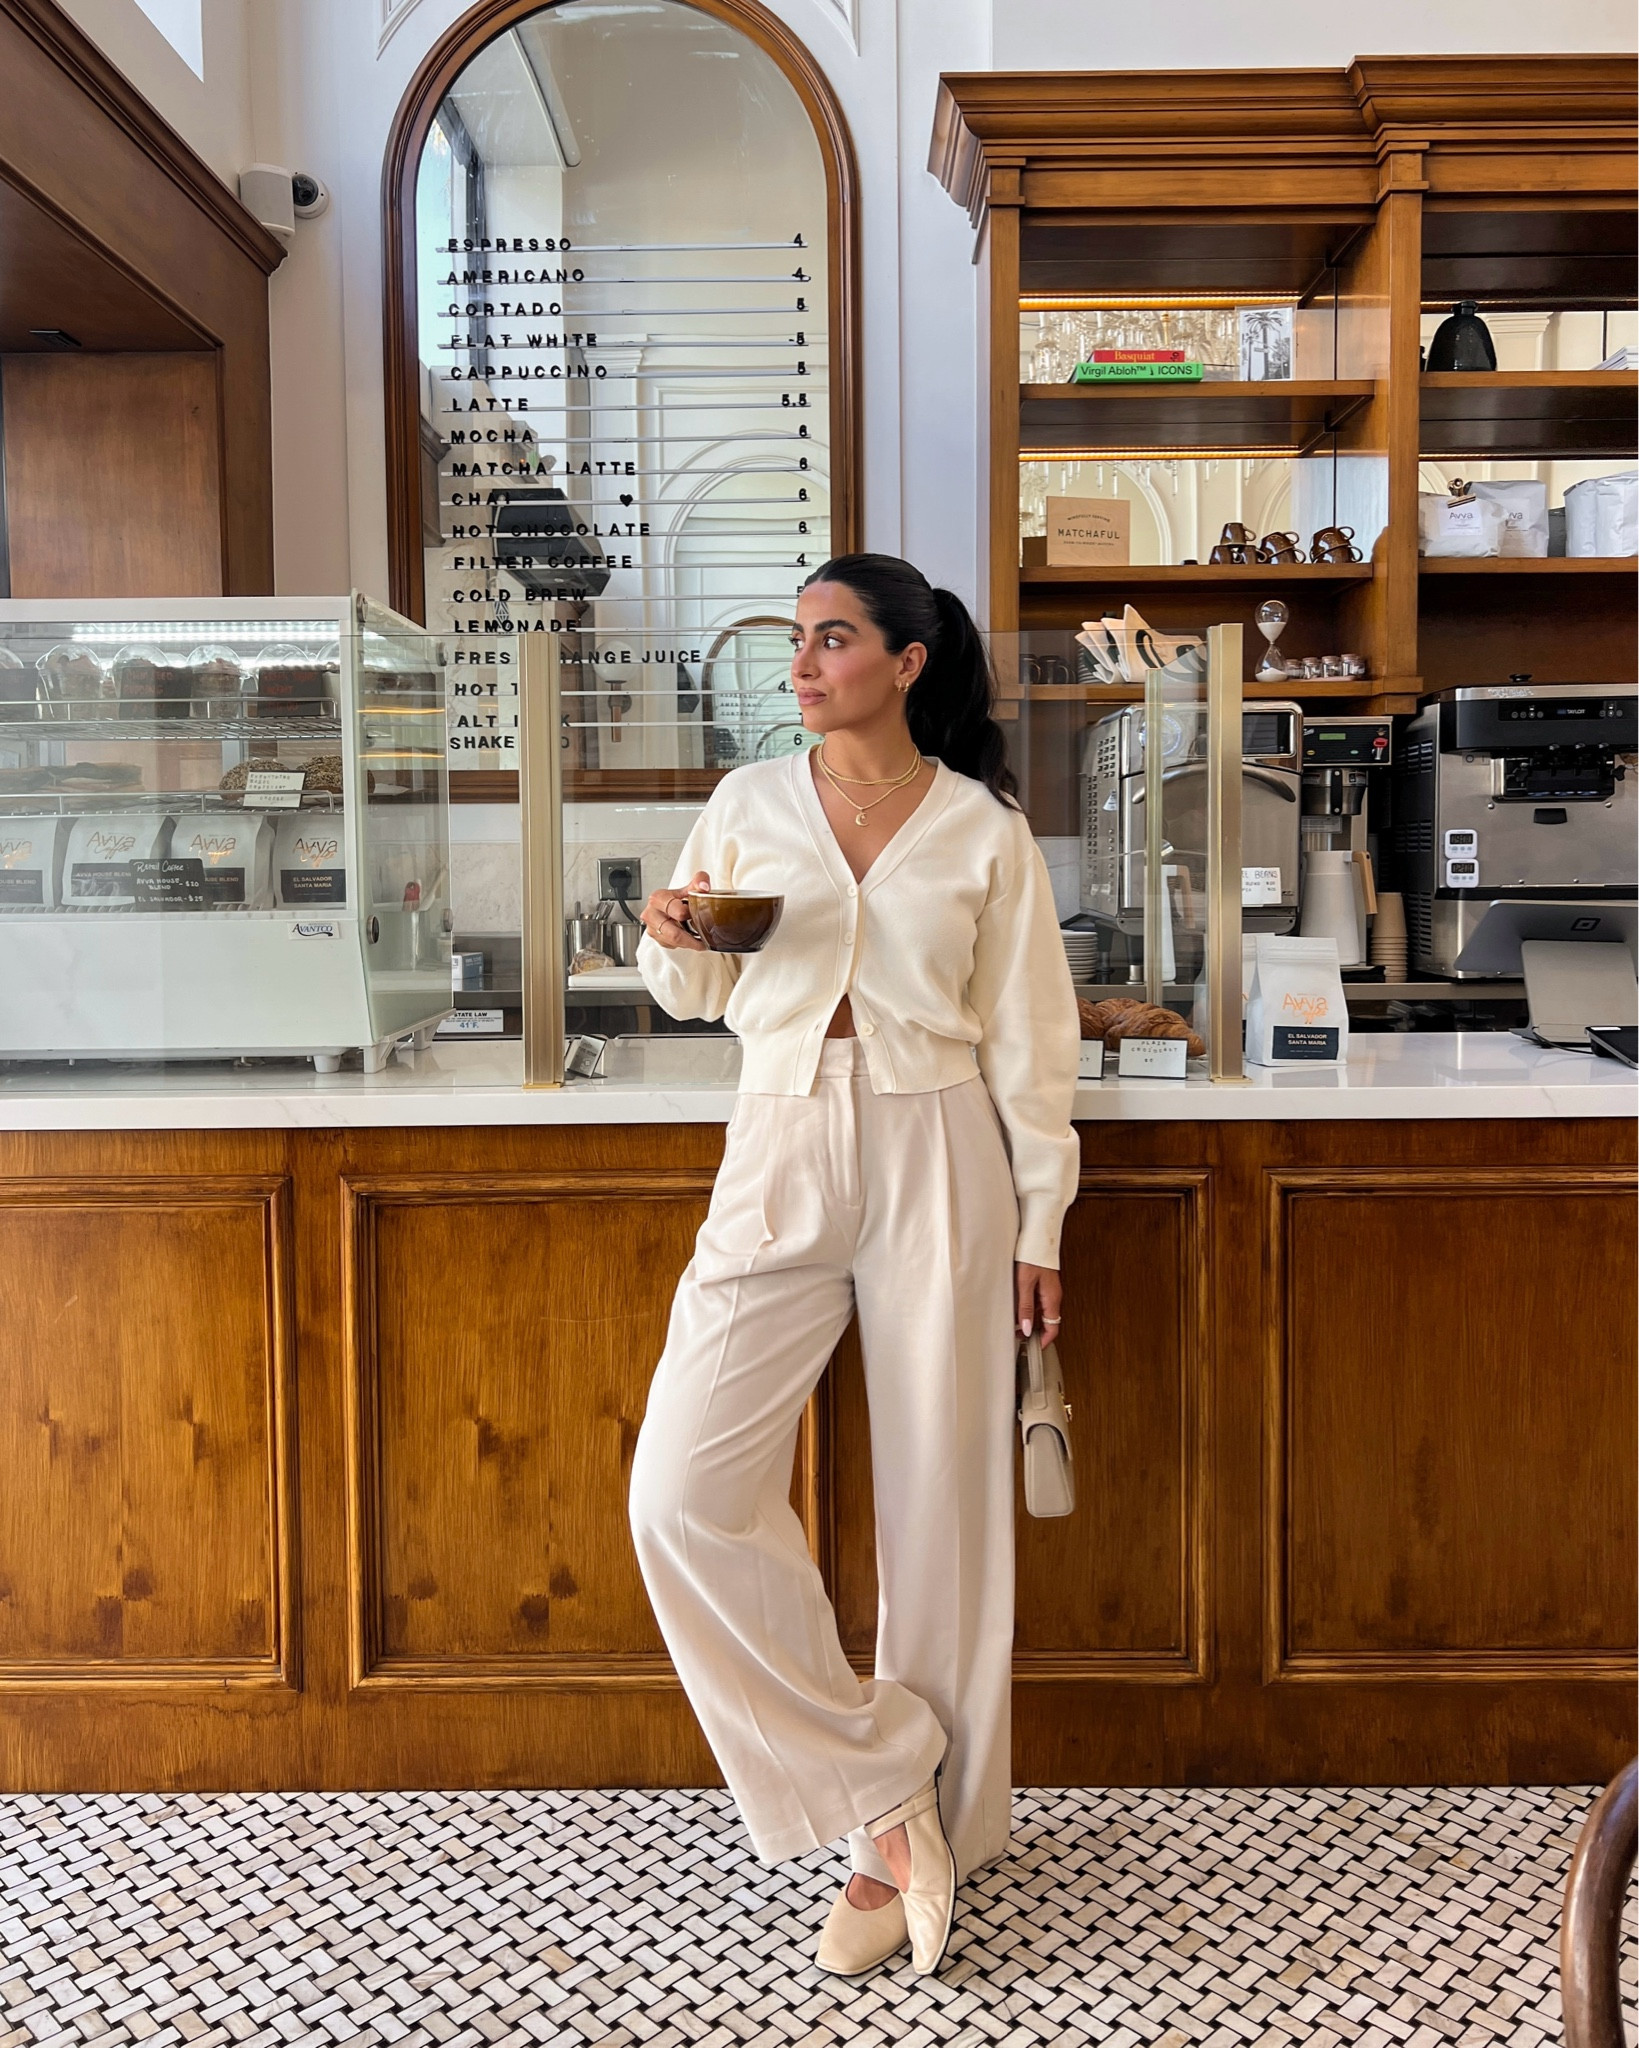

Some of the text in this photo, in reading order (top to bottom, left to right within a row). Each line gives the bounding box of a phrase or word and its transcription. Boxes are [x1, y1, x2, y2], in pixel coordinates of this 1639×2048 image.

[448, 233, 803, 251] ESPRESSO 4
[447, 268, 584, 284] AMERICANO
[449, 297, 805, 316] CORTADO 5
[451, 334, 512, 348] FLAT
[527, 333, 597, 347] WHITE
[1115, 351, 1155, 363] Basquiat
[451, 361, 806, 380] CAPPUCCINO 5
[1081, 366, 1106, 377] Virgil
[1158, 366, 1192, 375] ICONS
[452, 393, 807, 411] LATTE 5.5
[451, 424, 807, 444] MOCHA 6
[452, 457, 808, 477] MATCHA LATTE 6
[451, 488, 807, 506] CHAI 6
[452, 521, 807, 538] HOT CHOCOLATE 6
[1058, 528, 1120, 539] MATCHAFUL
[454, 553, 806, 569] FILTER COFFEE 4
[453, 589, 511, 602] COLD
[525, 588, 588, 601] BREW
[454, 620, 578, 633] LEMONADE
[454, 651, 511, 664] FRES
[642, 650, 701, 664] JUICE
[454, 683, 498, 696] HOT
[457, 715, 497, 727] ALT
[794, 733, 803, 745] 6
[133, 861, 160, 873] Retail
[1282, 992, 1328, 1010] Avva
